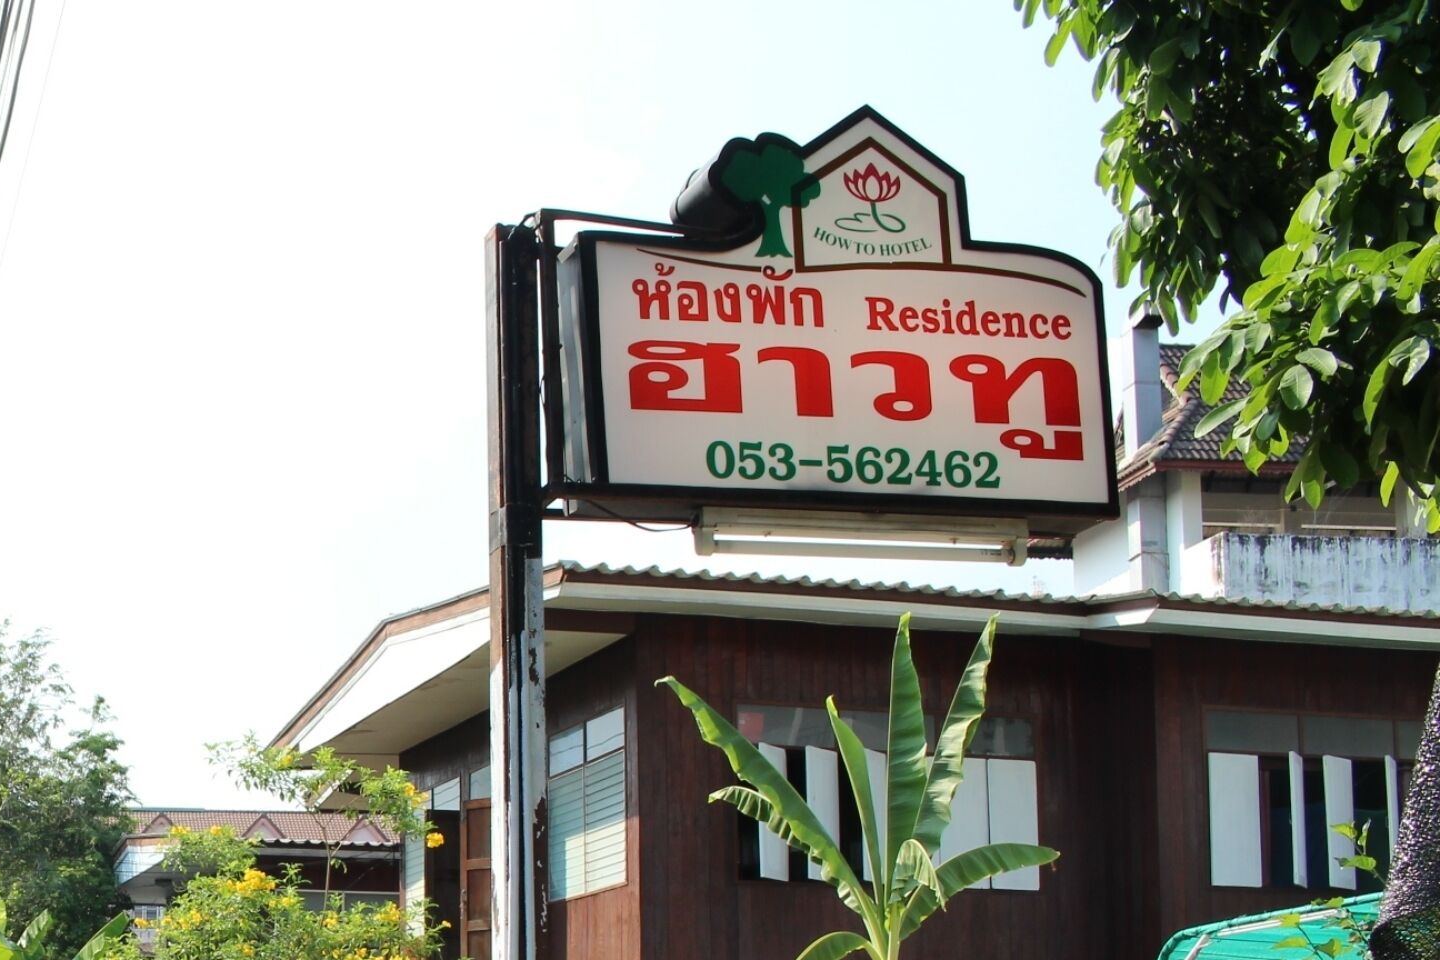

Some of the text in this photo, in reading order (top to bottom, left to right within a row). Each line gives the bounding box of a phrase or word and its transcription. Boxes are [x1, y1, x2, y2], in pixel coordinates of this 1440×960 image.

[813, 226, 933, 257] HOW TO HOTEL
[631, 263, 825, 328] ห้องพัก
[865, 296, 1072, 340] Residence
[626, 339, 1085, 461] ฮาวทู
[706, 439, 1001, 488] 053-562462
